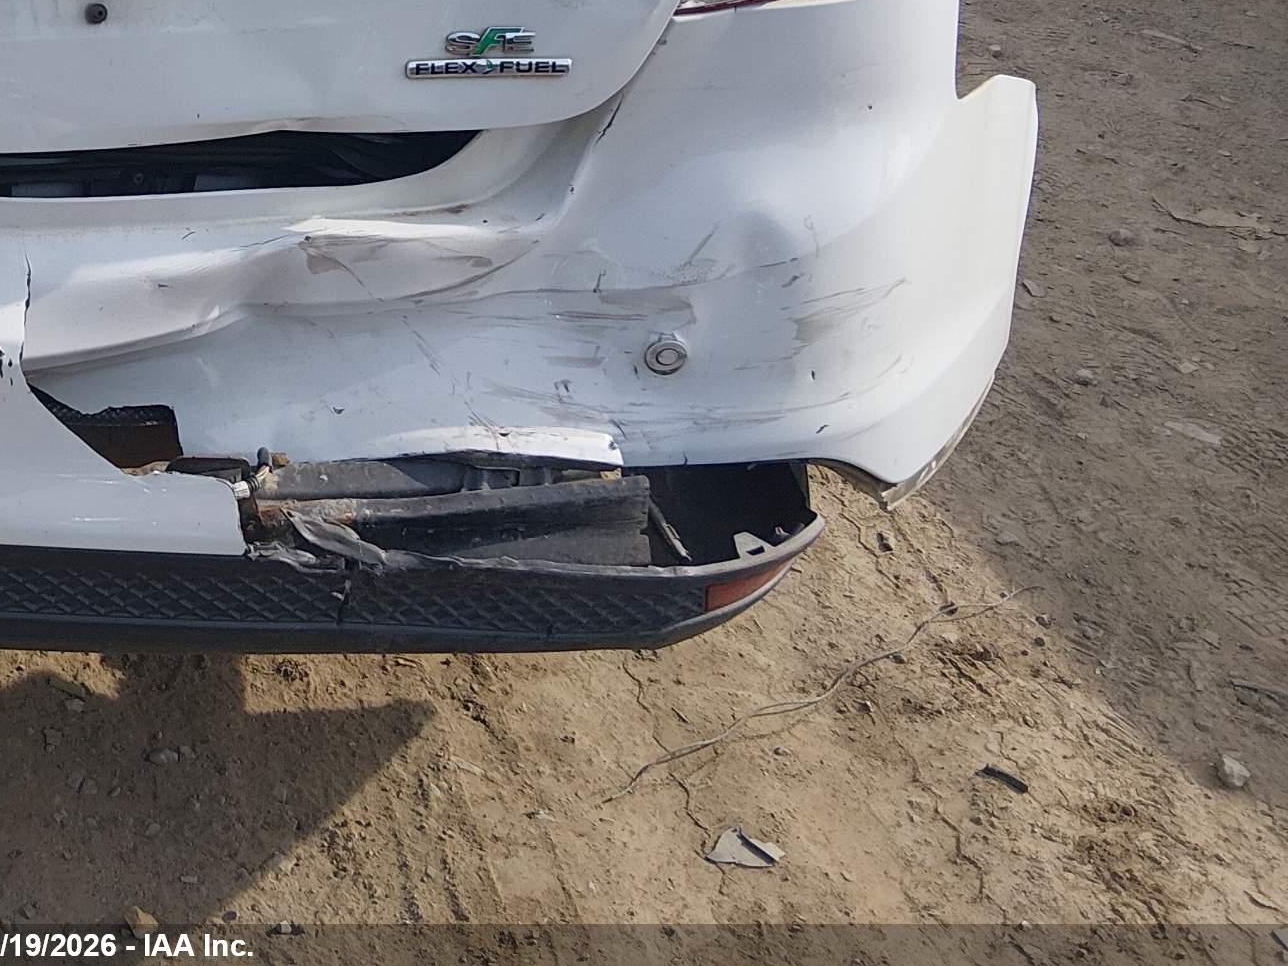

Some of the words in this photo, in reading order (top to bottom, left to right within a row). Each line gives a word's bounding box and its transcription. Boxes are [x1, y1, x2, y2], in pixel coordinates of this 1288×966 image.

[444, 26, 537, 57] SFE
[415, 62, 477, 76] FLEX
[499, 60, 566, 74] FUEL
